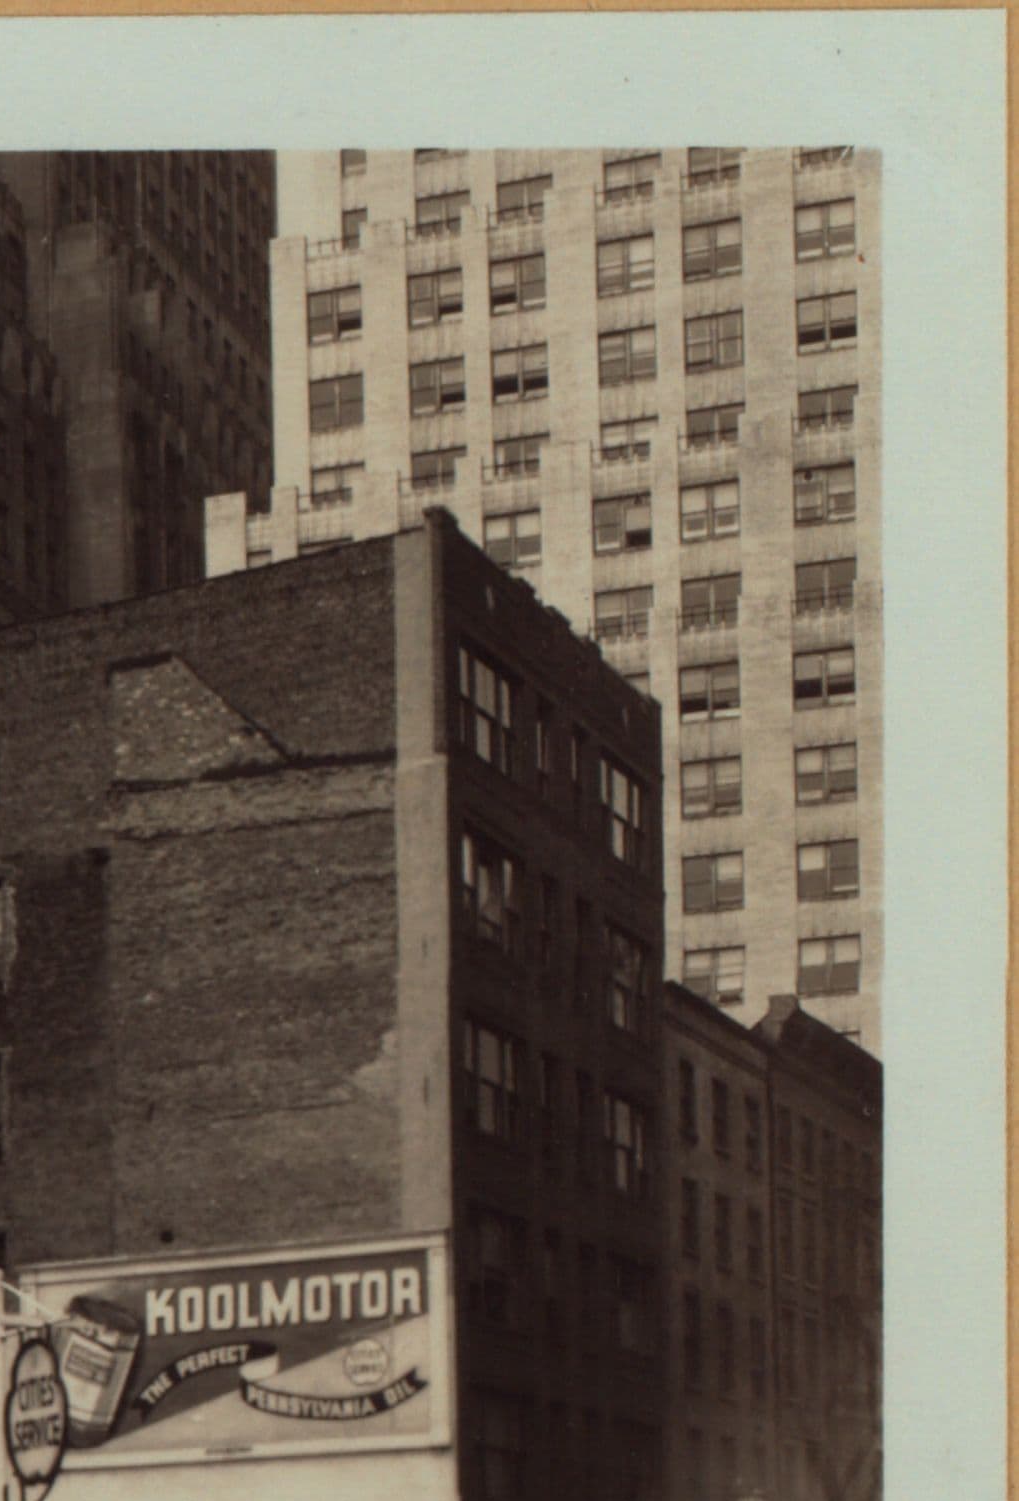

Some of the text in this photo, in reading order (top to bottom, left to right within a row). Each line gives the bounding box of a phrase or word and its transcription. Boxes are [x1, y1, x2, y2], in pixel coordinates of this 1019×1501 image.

[145, 1267, 421, 1337] KOOLMOTOR
[19, 1375, 55, 1411] CITIES
[140, 1371, 173, 1405] THE
[175, 1343, 250, 1379] PERFECT
[385, 1379, 418, 1406] OIL
[13, 1414, 61, 1451] SERVICE
